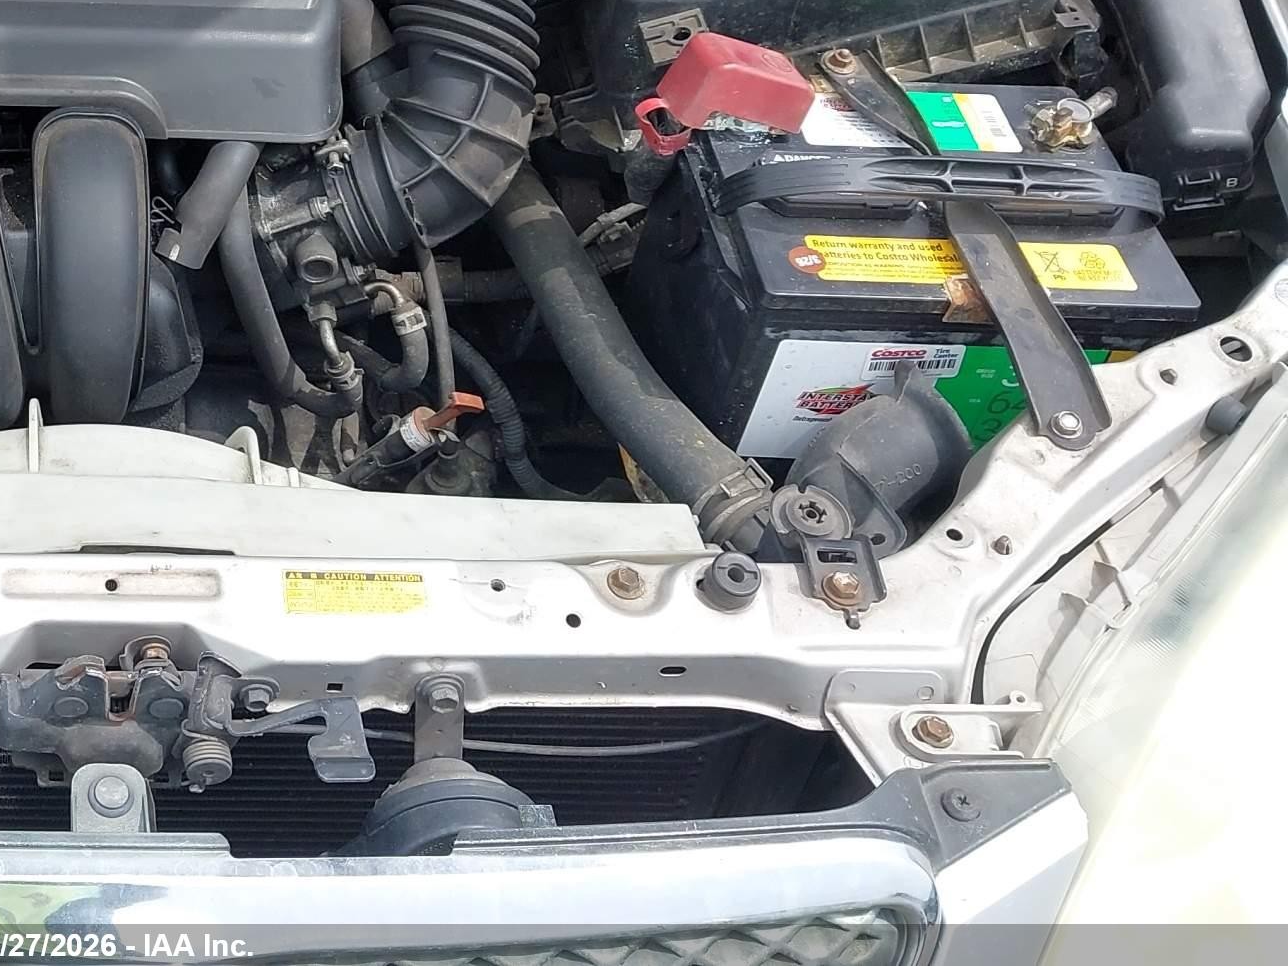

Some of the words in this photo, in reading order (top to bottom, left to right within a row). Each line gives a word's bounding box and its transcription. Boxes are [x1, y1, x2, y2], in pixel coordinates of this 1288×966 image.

[1225, 177, 1239, 188] B
[812, 239, 848, 250] Return
[849, 241, 895, 253] warranty
[896, 241, 915, 252] and
[917, 242, 943, 253] used
[822, 250, 861, 261] atteries
[862, 251, 874, 261] to
[875, 251, 909, 262] Costco
[910, 252, 961, 264] Wholesal
[871, 348, 927, 358] COSTCO
[799, 391, 868, 402] INTERSTA
[799, 400, 862, 410] BATTER
[324, 572, 367, 581] CAUTION
[374, 573, 421, 582] ATTENTION
